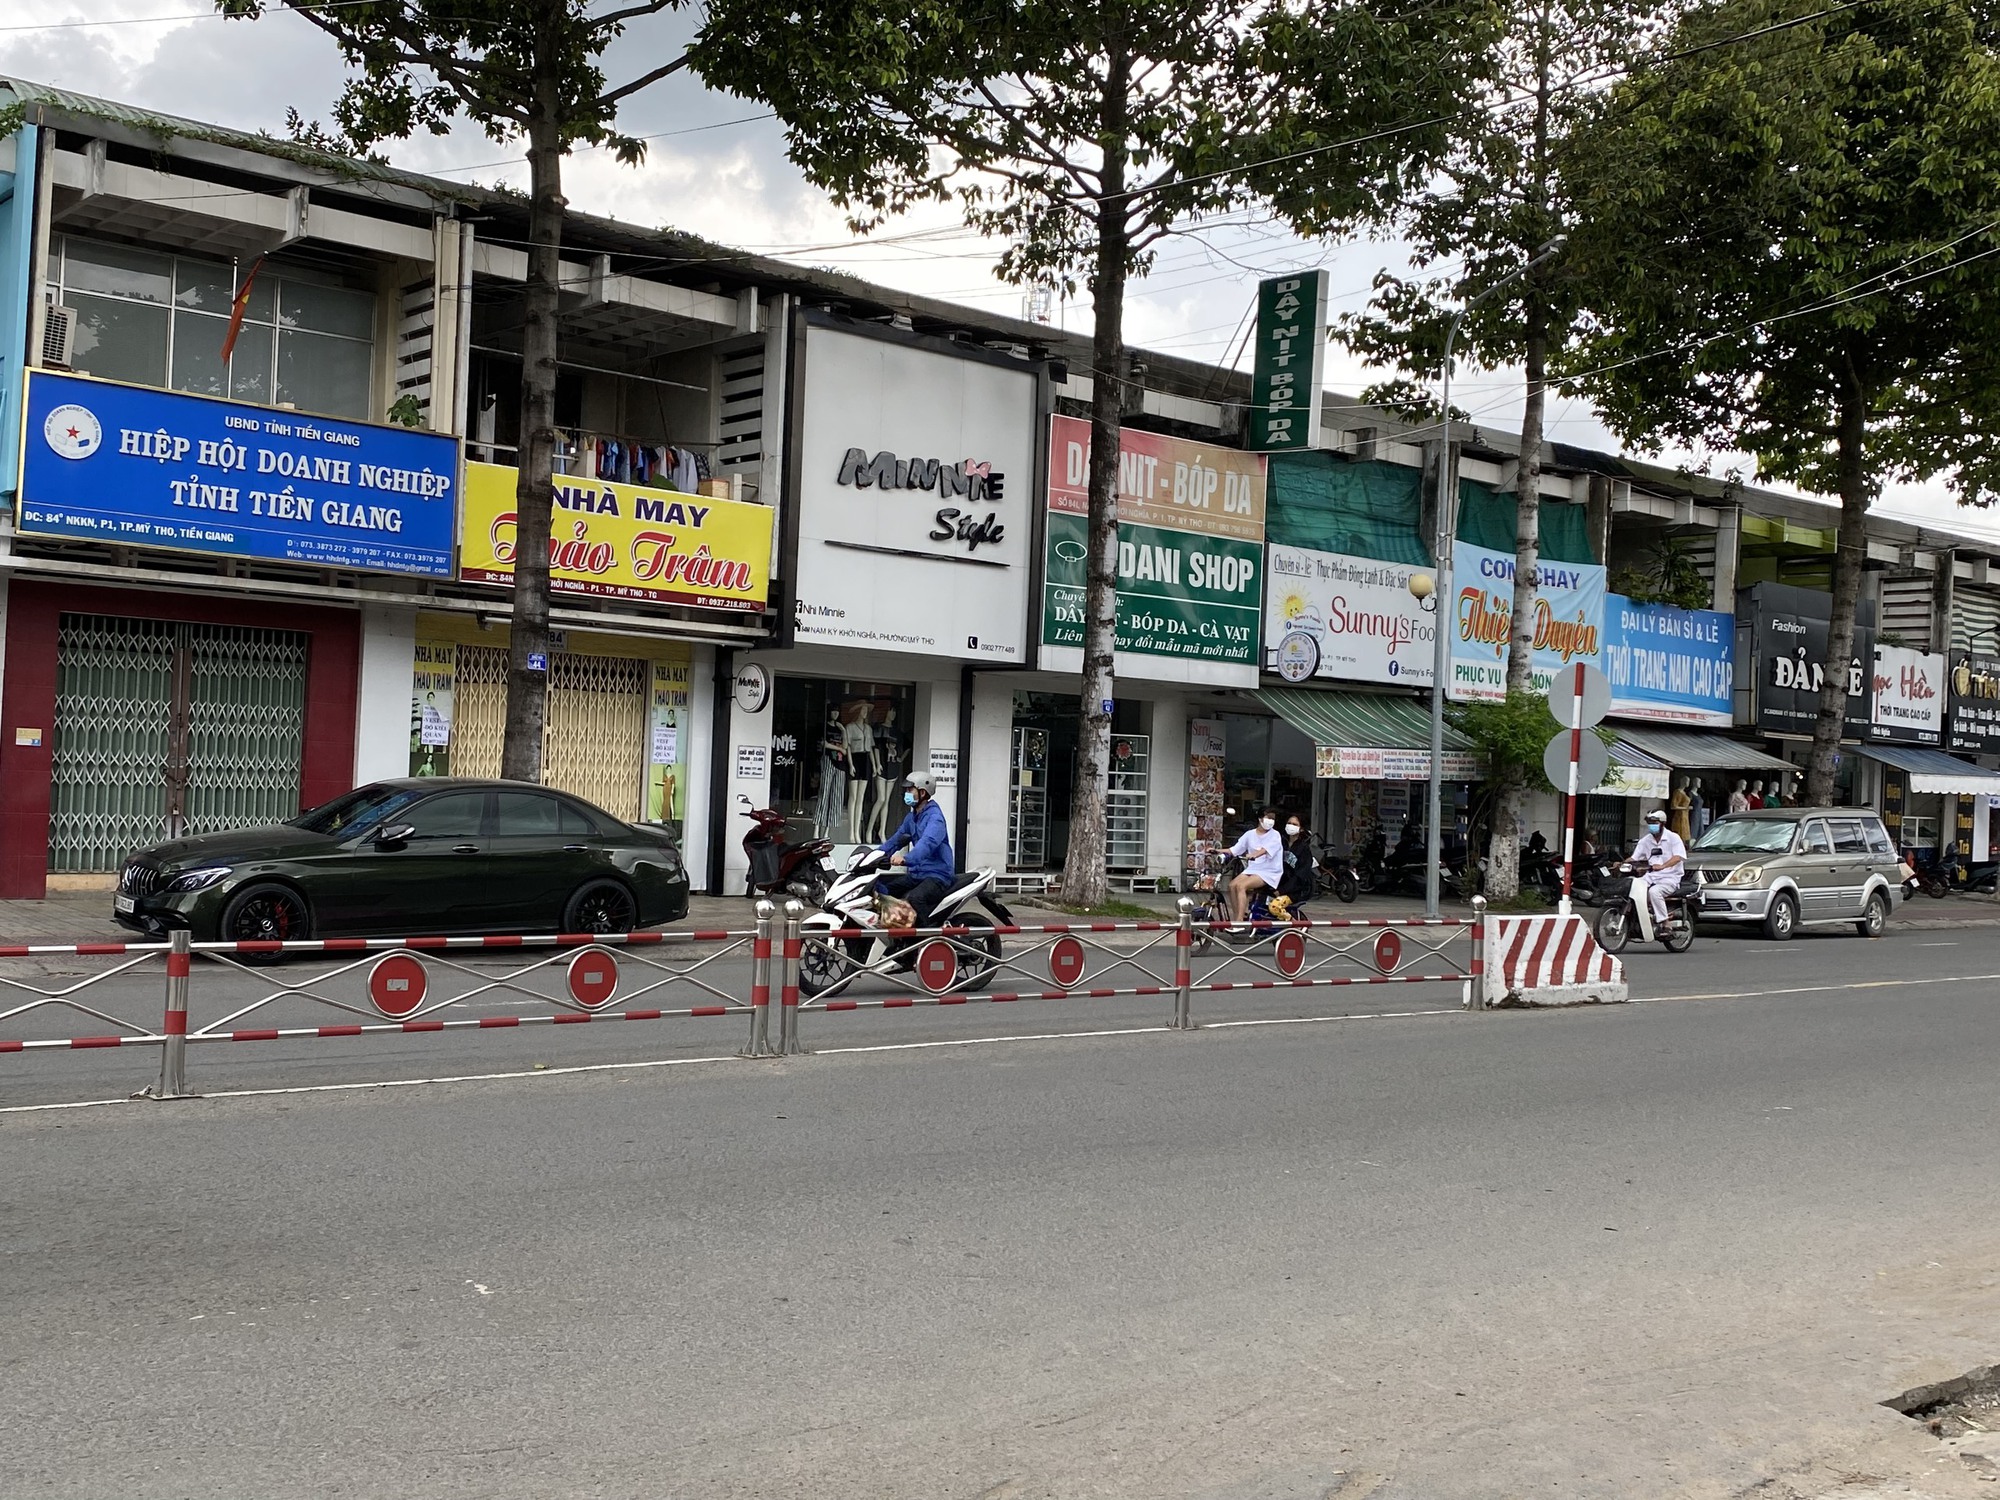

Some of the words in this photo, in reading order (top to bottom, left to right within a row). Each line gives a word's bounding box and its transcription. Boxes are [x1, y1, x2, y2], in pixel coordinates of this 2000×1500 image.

[1274, 280, 1300, 320] DÂY
[1269, 372, 1294, 414] BÓP
[225, 416, 260, 431] UBND
[264, 420, 292, 436] TỈNH
[324, 432, 360, 446] GIANG
[1266, 418, 1292, 444] DA
[118, 428, 190, 464] HIỆP
[197, 437, 248, 474] HỘI
[258, 449, 351, 484] DOANH
[358, 464, 450, 501] NGHIỆP
[1120, 451, 1158, 506] NỊT
[1174, 454, 1218, 508] BÓP
[1224, 470, 1252, 516] DA
[170, 474, 240, 512] TỈNH
[249, 485, 314, 521] TIỀN
[322, 500, 402, 532] GIANG
[552, 487, 620, 516] NHÀ
[635, 498, 710, 528] MAY
[25, 510, 43, 521] ĐC:
[66, 515, 98, 529] NKKN,
[100, 519, 116, 531] P1,
[154, 525, 178, 538] THO,
[206, 531, 234, 542] GIANG
[930, 508, 1005, 551] Style
[1190, 518, 1203, 527] THO
[630, 531, 752, 590] Trâm
[1118, 541, 1180, 584] DANI
[1189, 551, 1254, 593] SHOP
[564, 580, 585, 590] NGHĨA
[618, 586, 628, 595] MỸ
[630, 589, 643, 598] THO
[1054, 590, 1087, 604] Chuyê
[818, 606, 845, 618] Minnie
[1054, 604, 1086, 623] DÂY
[1131, 612, 1164, 632] BÓP
[1167, 621, 1188, 635] DA
[1200, 620, 1220, 638] CÀ
[1224, 625, 1250, 644] VẠT
[1329, 596, 1410, 655] Sunny's
[1622, 610, 1640, 634] ĐẠI
[1642, 610, 1656, 633] LÝ
[1659, 614, 1680, 637] BÁN
[1684, 615, 1693, 640] SỈ
[1696, 623, 1703, 641] &
[1706, 618, 1718, 643] LẺ
[1772, 618, 1807, 634] Fashion
[435, 647, 452, 664] MAY
[1054, 628, 1083, 642] Liên
[1114, 636, 1133, 649] hay
[1135, 636, 1153, 649] đổi
[1154, 638, 1180, 652] mẫu
[1182, 643, 1201, 654] mã
[1202, 645, 1222, 656] mới
[673, 667, 688, 682] MAY
[1401, 666, 1424, 678] Sunny's
[1456, 665, 1484, 686] PHỤC
[1488, 668, 1502, 688] VỤ
[1606, 635, 1631, 686] THỜI
[1634, 648, 1667, 691] TRANG
[1669, 653, 1691, 694] NAM
[1692, 656, 1712, 698] CAO
[1714, 646, 1733, 700] CẤP
[1901, 665, 1935, 700] Hiền
[1893, 707, 1909, 718] TRANG
[774, 755, 795, 767] Style
